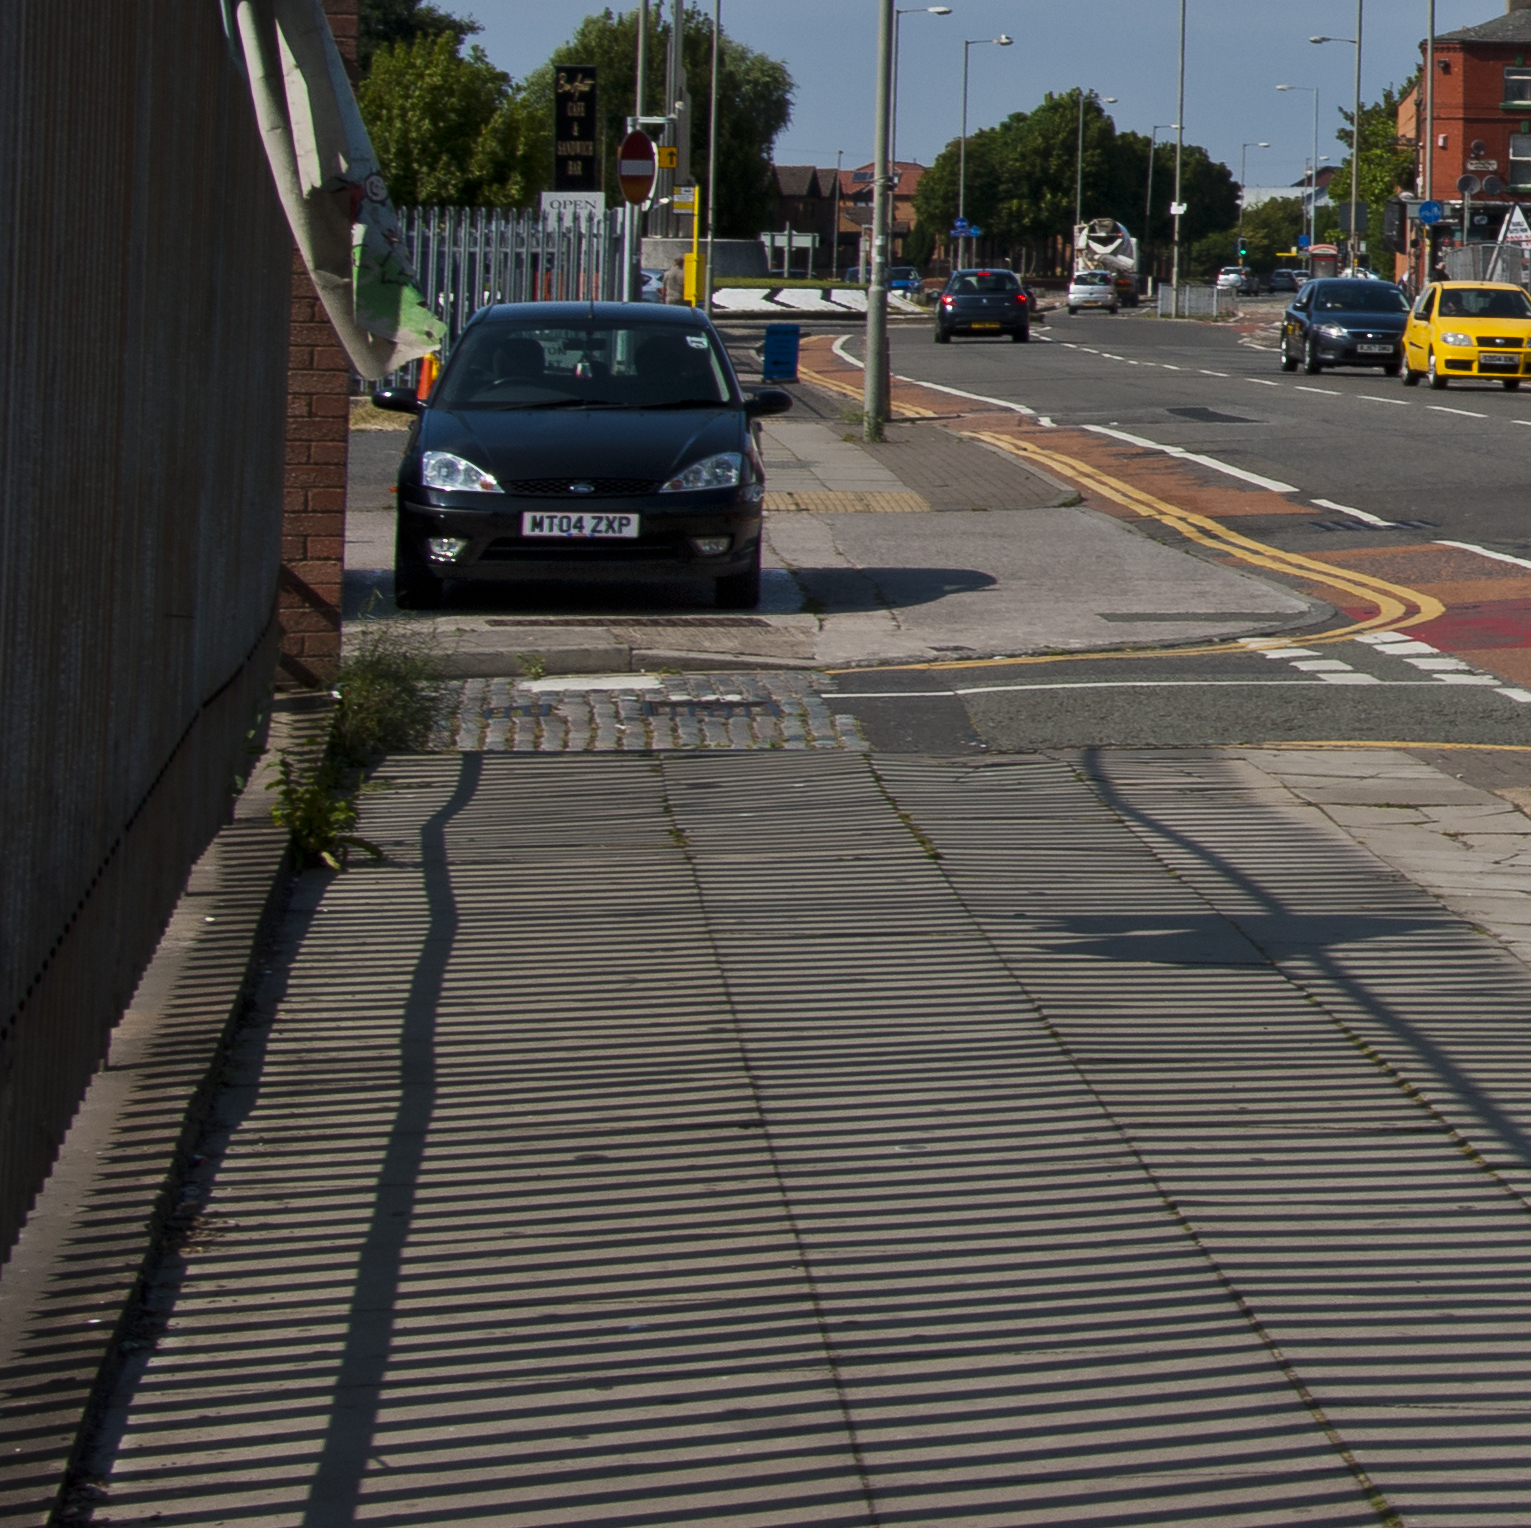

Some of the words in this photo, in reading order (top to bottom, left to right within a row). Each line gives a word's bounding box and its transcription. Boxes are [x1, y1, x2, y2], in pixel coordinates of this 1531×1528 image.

[550, 199, 597, 210] OPEN
[531, 515, 586, 533] MT04
[591, 516, 632, 534] ZXP
